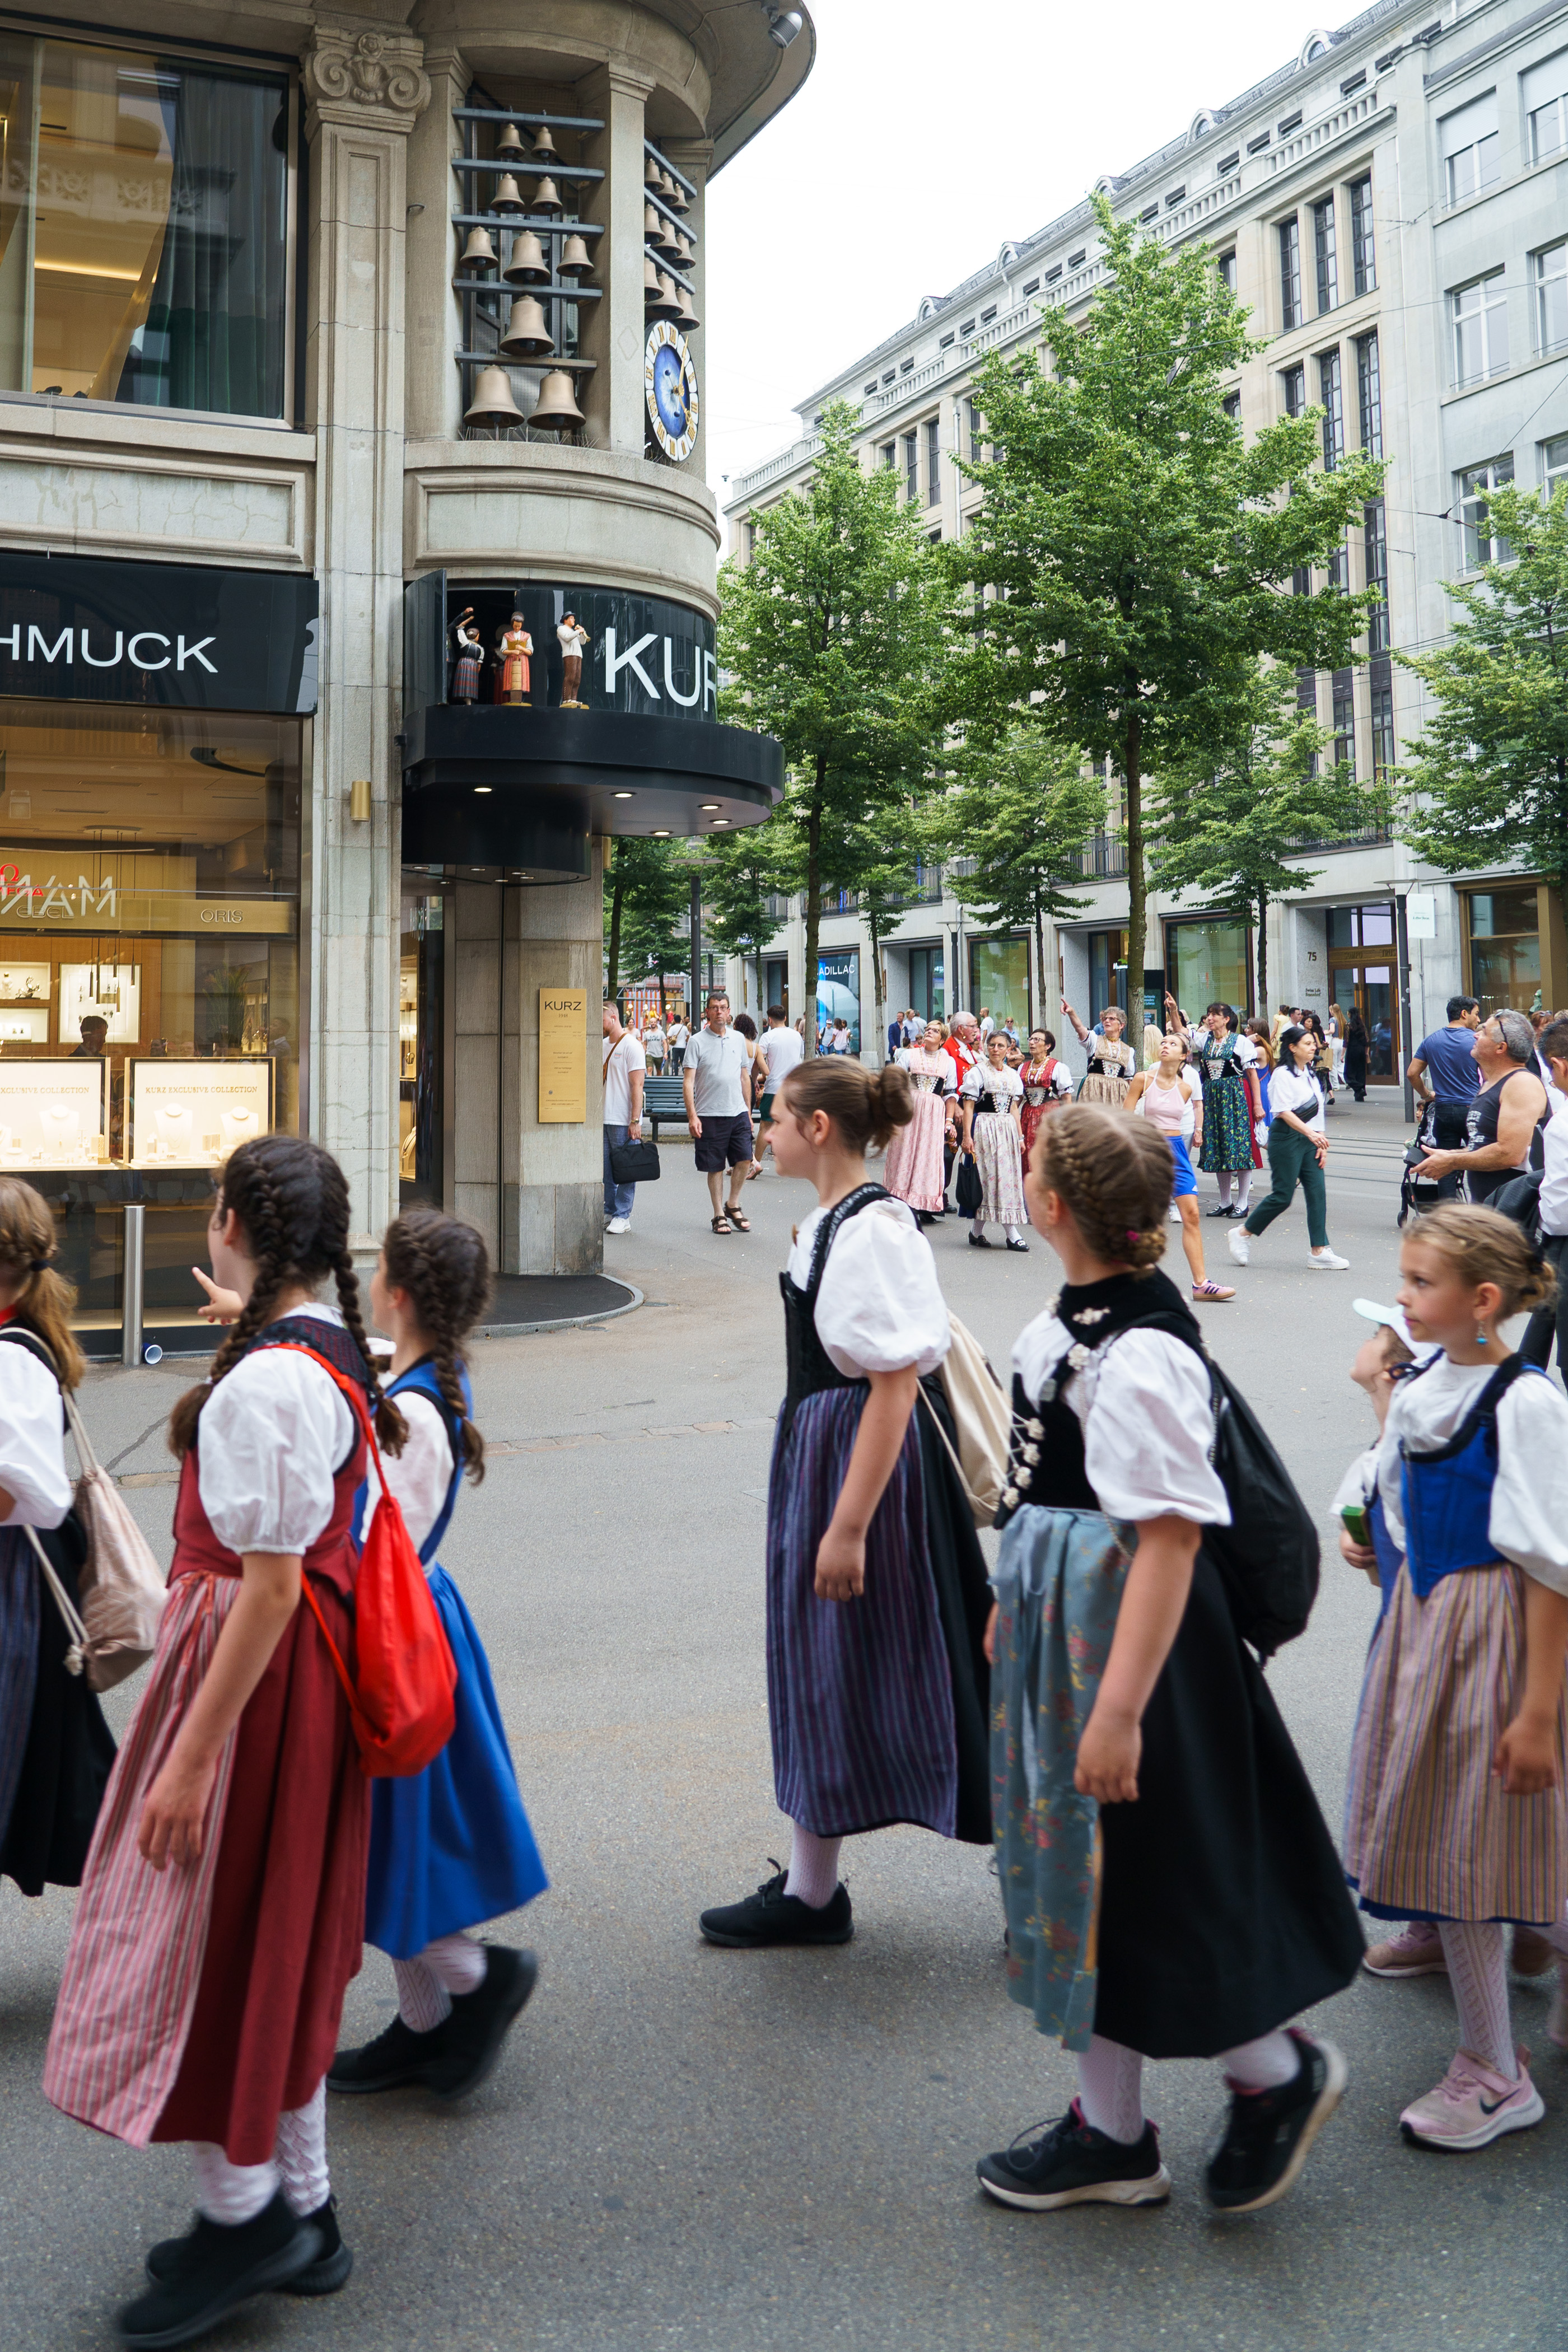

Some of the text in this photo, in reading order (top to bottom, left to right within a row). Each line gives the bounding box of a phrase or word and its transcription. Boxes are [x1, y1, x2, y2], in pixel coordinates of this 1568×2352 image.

[0, 624, 218, 673] HMUCK
[200, 908, 244, 923] ORIS
[1308, 952, 1317, 962] 75
[817, 964, 855, 976] ADILLAC
[545, 1001, 582, 1011] KURZ
